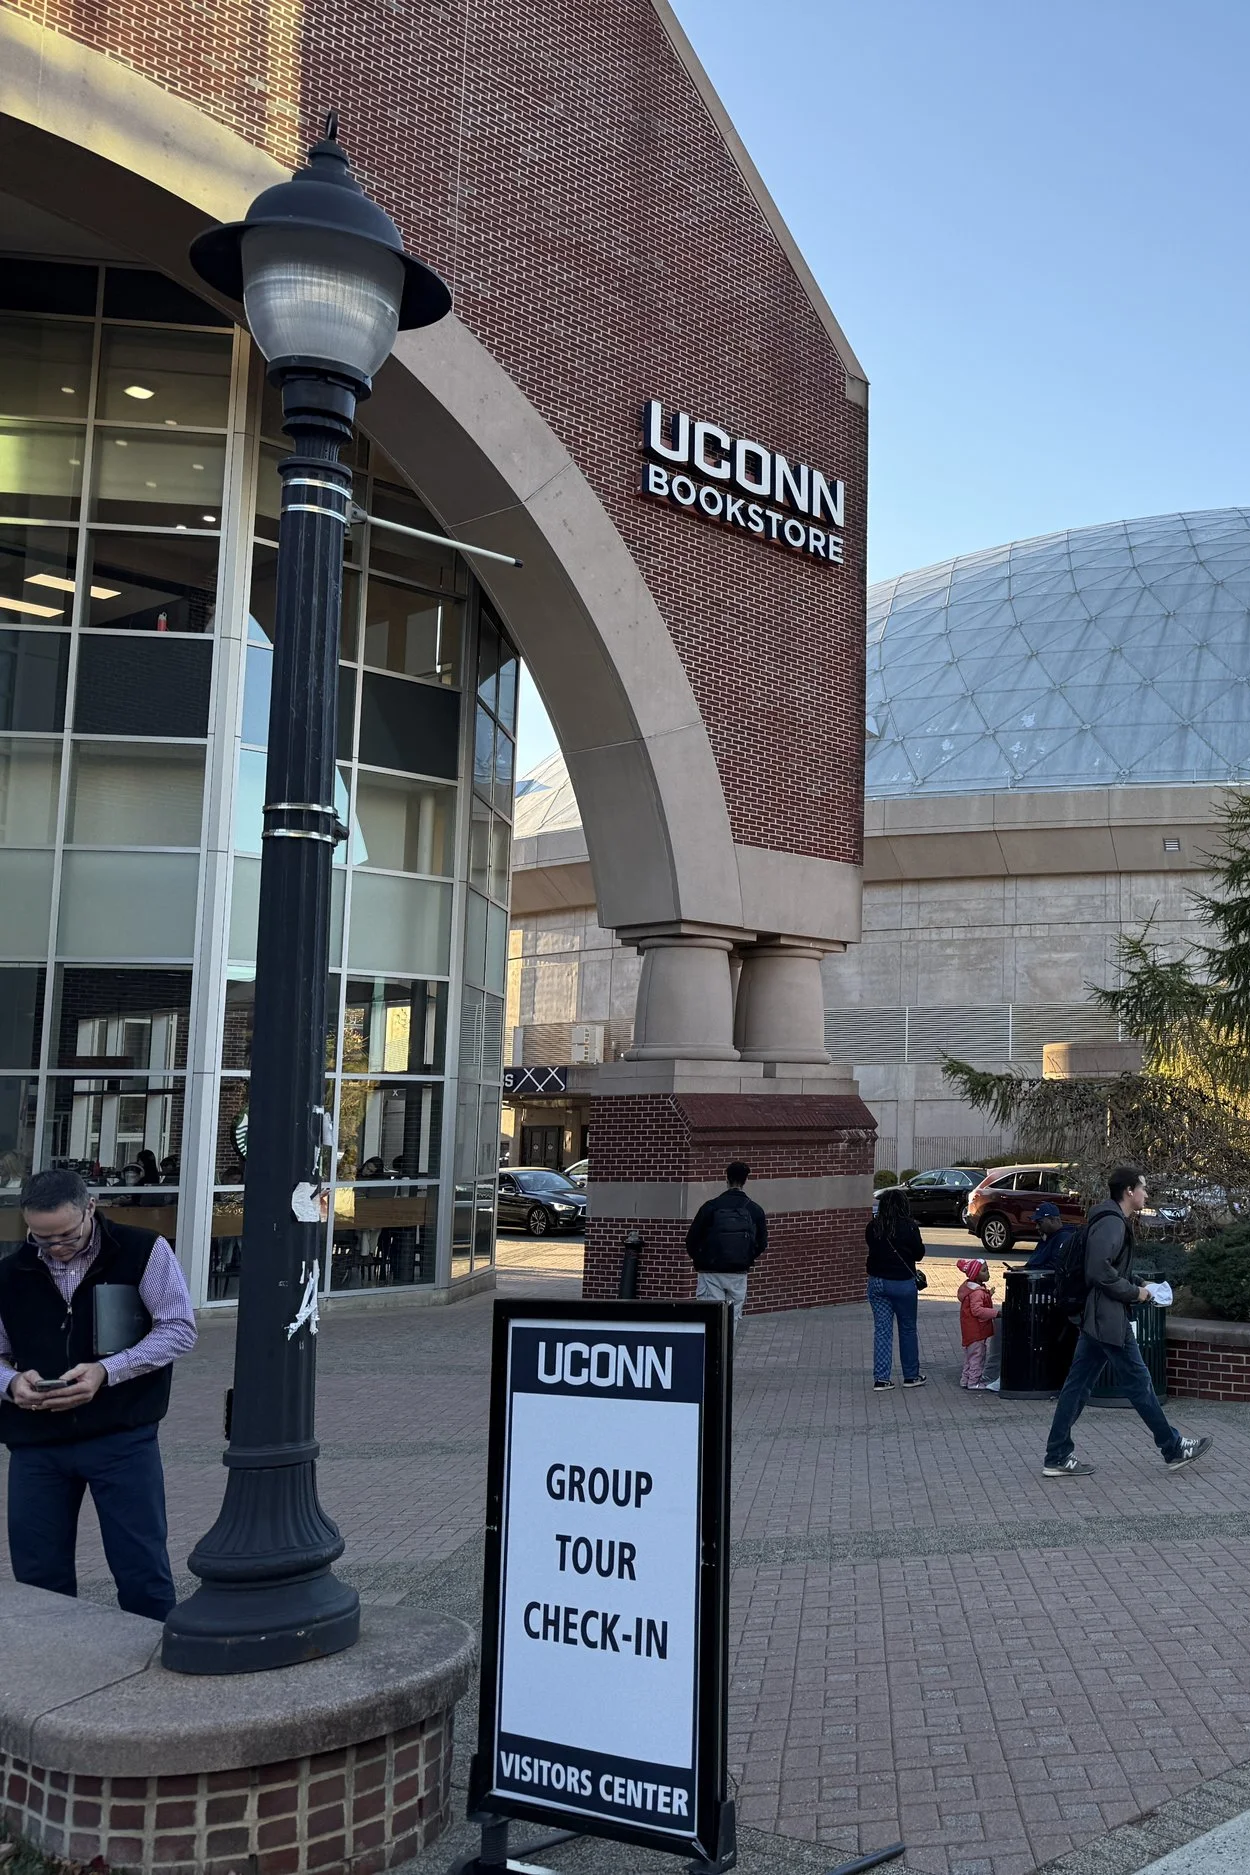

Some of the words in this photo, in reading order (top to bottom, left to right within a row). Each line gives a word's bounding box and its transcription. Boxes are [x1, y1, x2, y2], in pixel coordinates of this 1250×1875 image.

[648, 400, 844, 527] UCONN
[646, 463, 844, 565] BOOKSTORE
[537, 1341, 673, 1390] UCONN
[546, 1463, 653, 1509] GROUP
[555, 1534, 636, 1581] TOUR
[523, 1601, 668, 1660] CHECK-IN
[500, 1751, 593, 1797] VISITORS
[599, 1773, 689, 1817] CENTER
